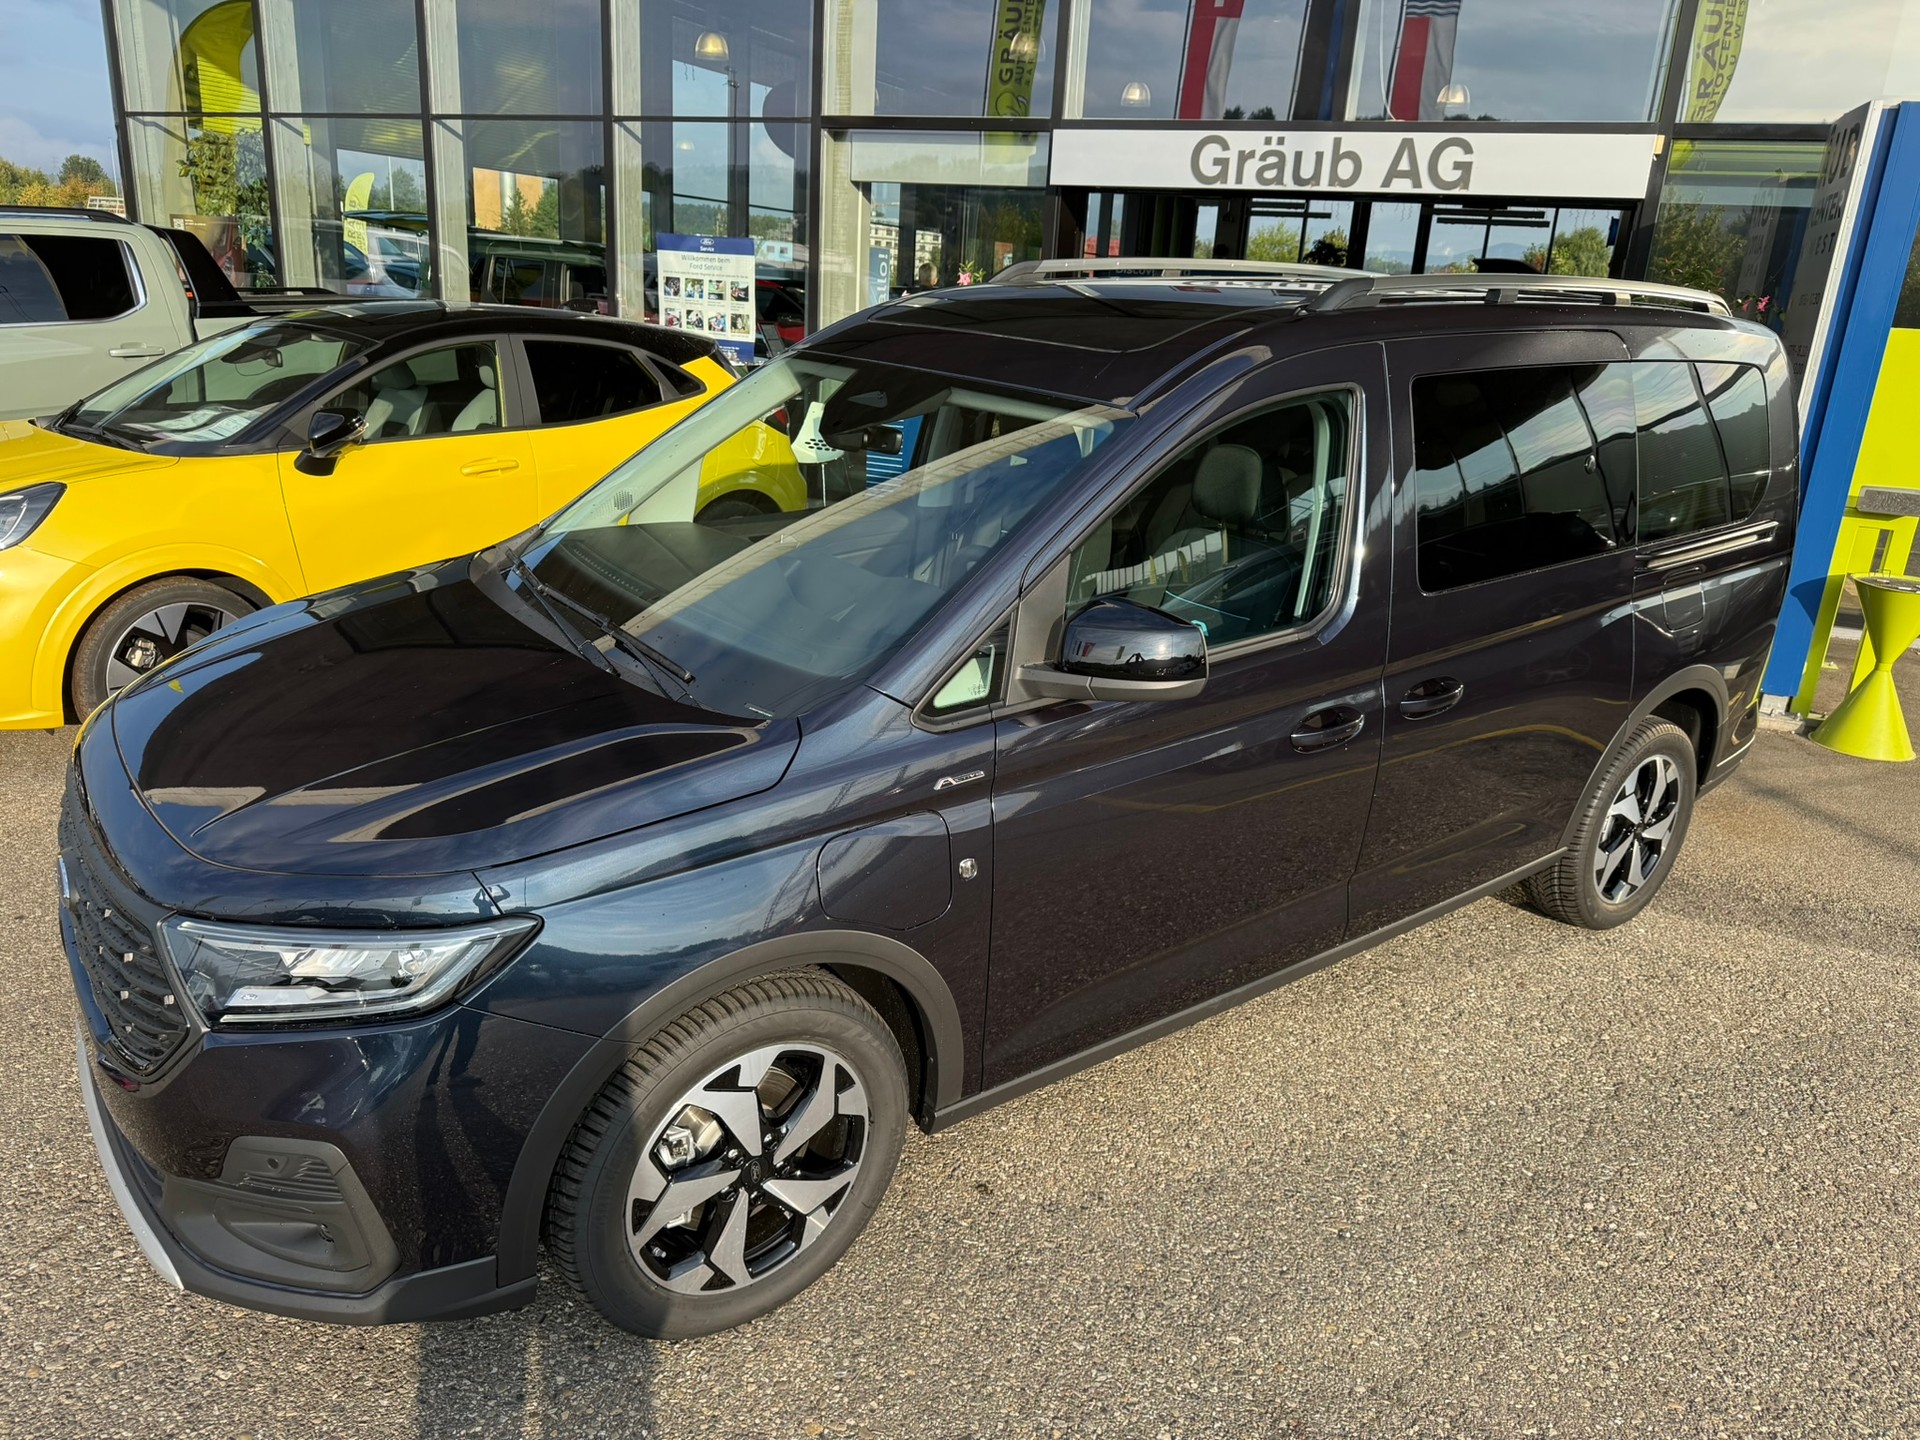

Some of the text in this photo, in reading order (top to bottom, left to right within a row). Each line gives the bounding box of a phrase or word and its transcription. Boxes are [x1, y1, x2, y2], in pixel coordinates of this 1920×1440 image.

[999, 0, 1024, 85] GRÄU
[1691, 0, 1726, 121] GRÄU
[1190, 134, 1474, 191] Gräub AG
[681, 254, 717, 263] Willkommen
[703, 263, 723, 271] Service
